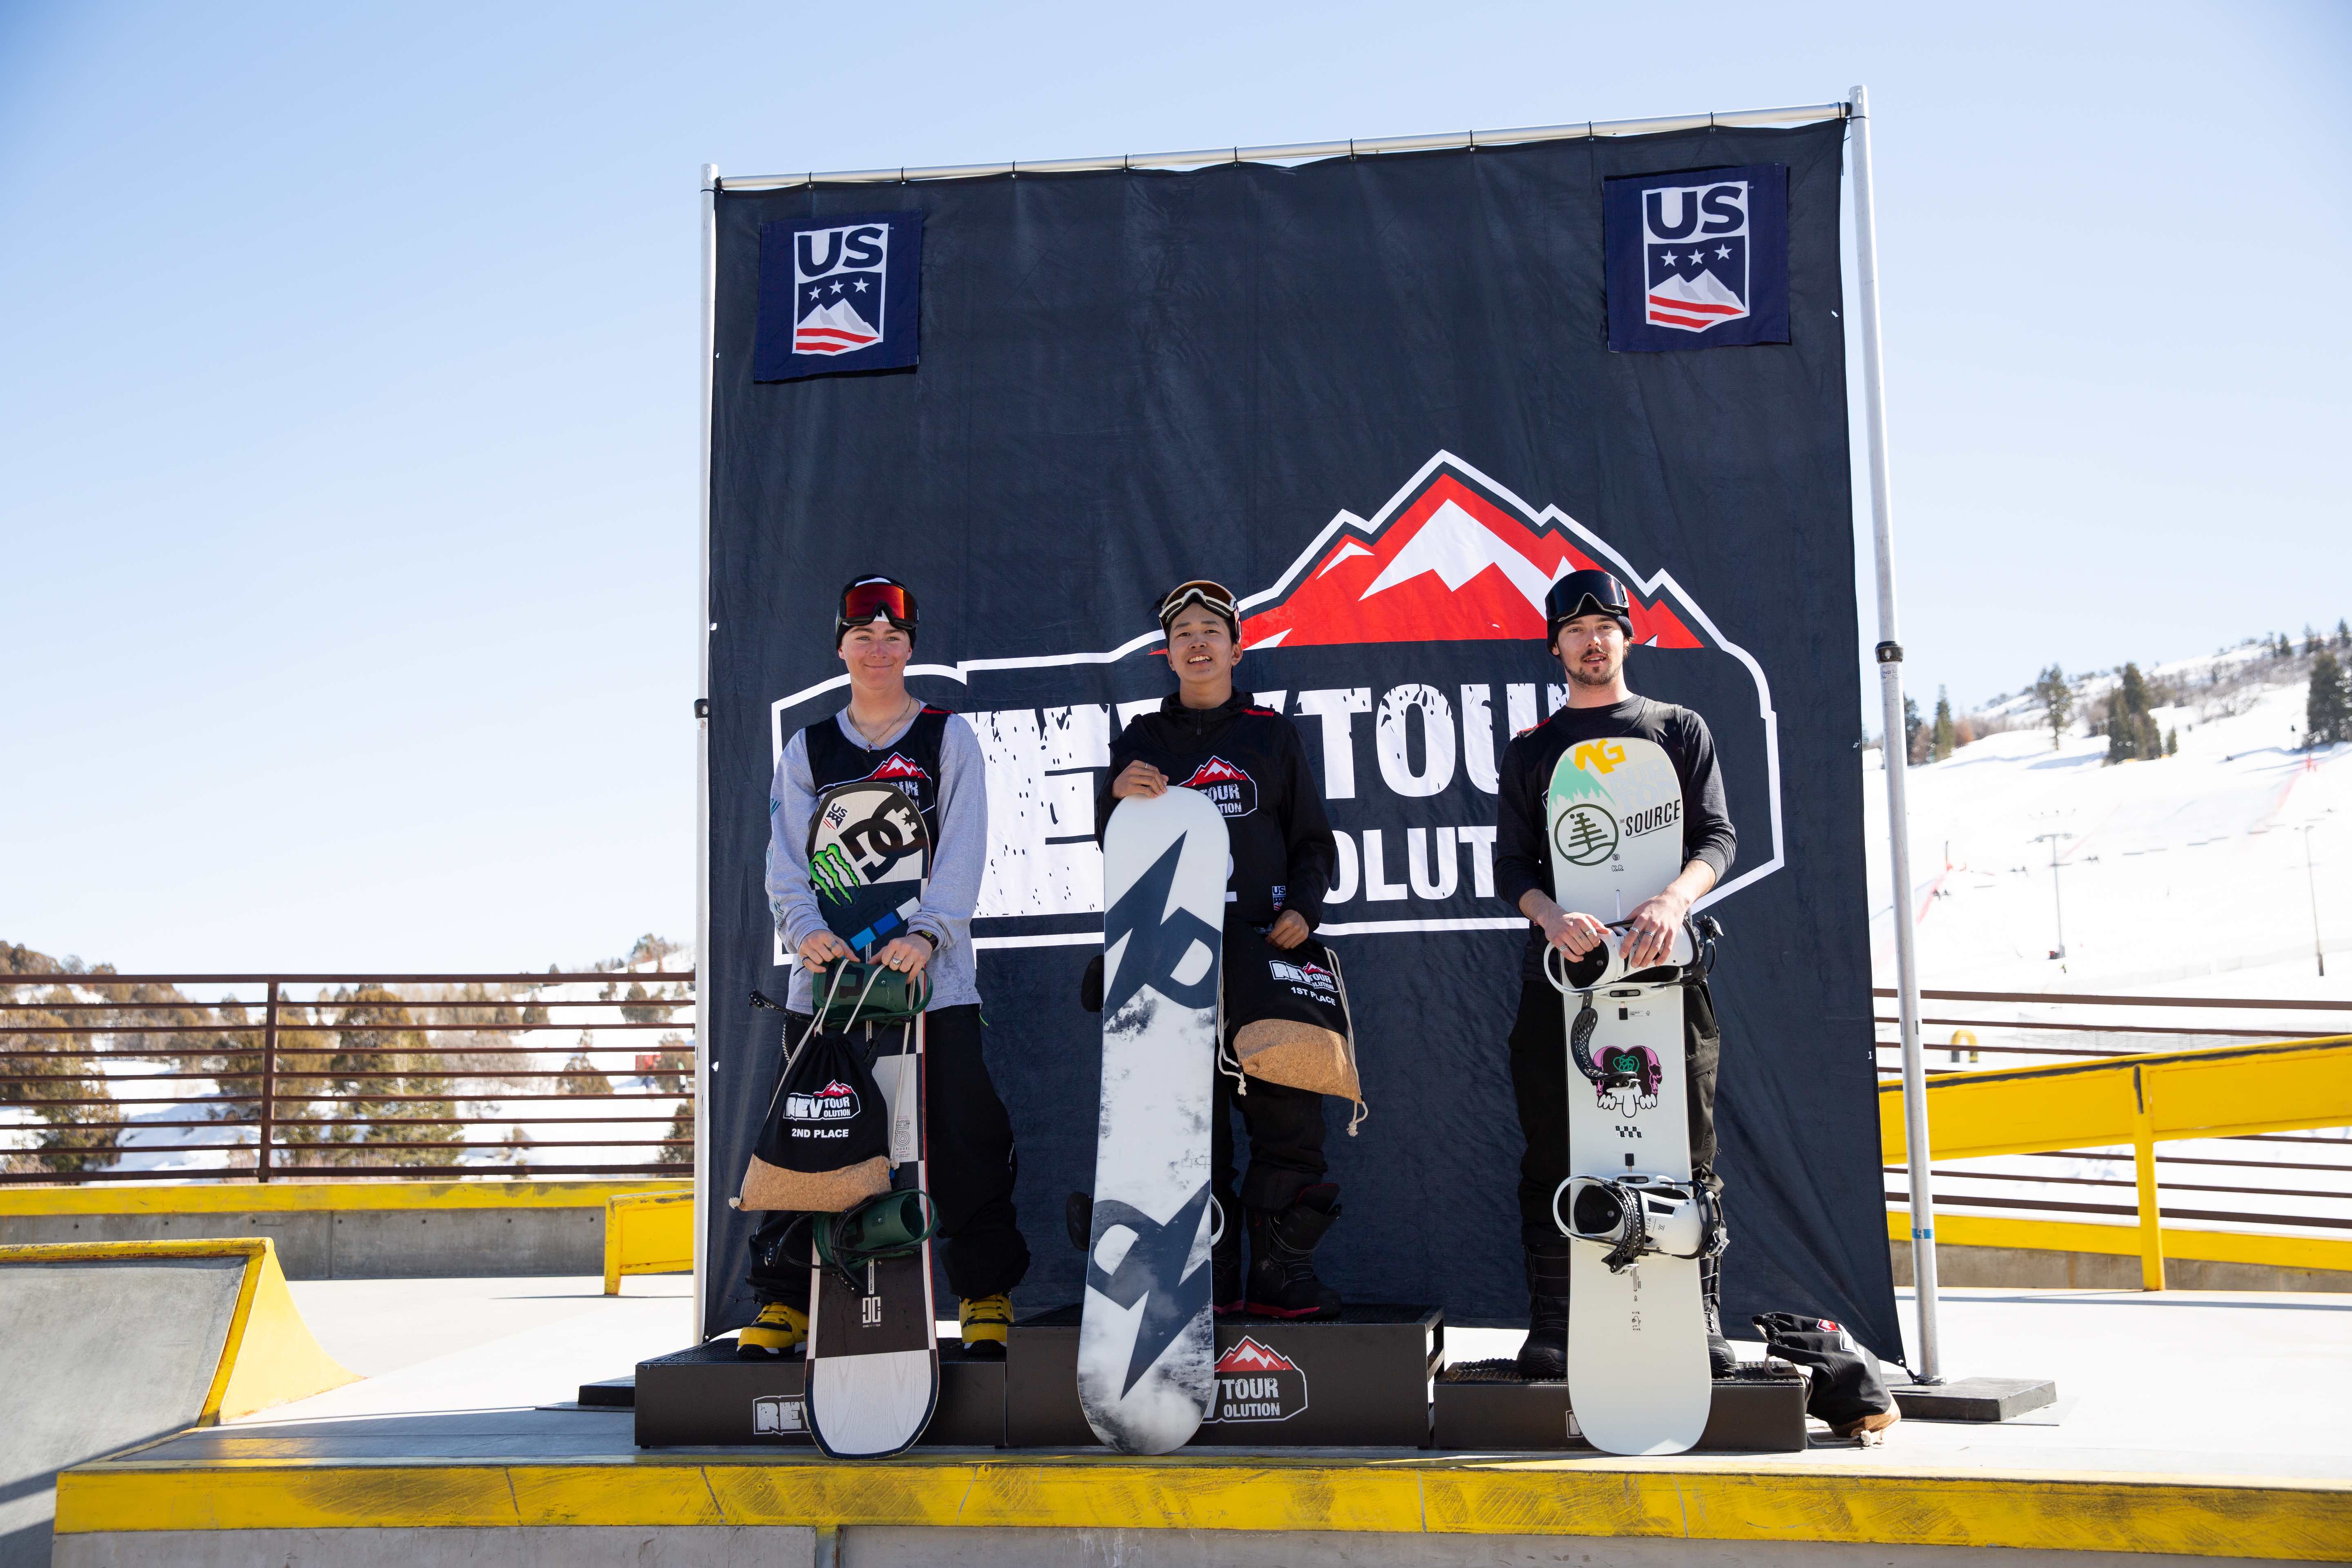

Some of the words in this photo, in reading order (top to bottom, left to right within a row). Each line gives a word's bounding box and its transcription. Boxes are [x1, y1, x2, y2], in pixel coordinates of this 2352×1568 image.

[1646, 185, 1744, 240] US
[798, 227, 884, 277] US
[1293, 683, 1570, 800] TOU
[831, 803, 848, 818] US
[1218, 802, 1242, 814] TION
[1625, 799, 1680, 837] SOURCE
[1273, 886, 1285, 895] US
[1272, 963, 1311, 984] REV
[1309, 973, 1332, 984] TOUR
[1291, 987, 1308, 996] 1ST
[1310, 991, 1336, 1006] PLACE
[785, 1097, 824, 1118] REV
[823, 1096, 850, 1108] TOUR
[824, 1109, 851, 1118] OLUTION
[791, 1128, 811, 1138] 2ND
[813, 1129, 849, 1138] PLACE
[1222, 1378, 1279, 1399] TOUR
[1223, 1402, 1281, 1417] OLUTION
